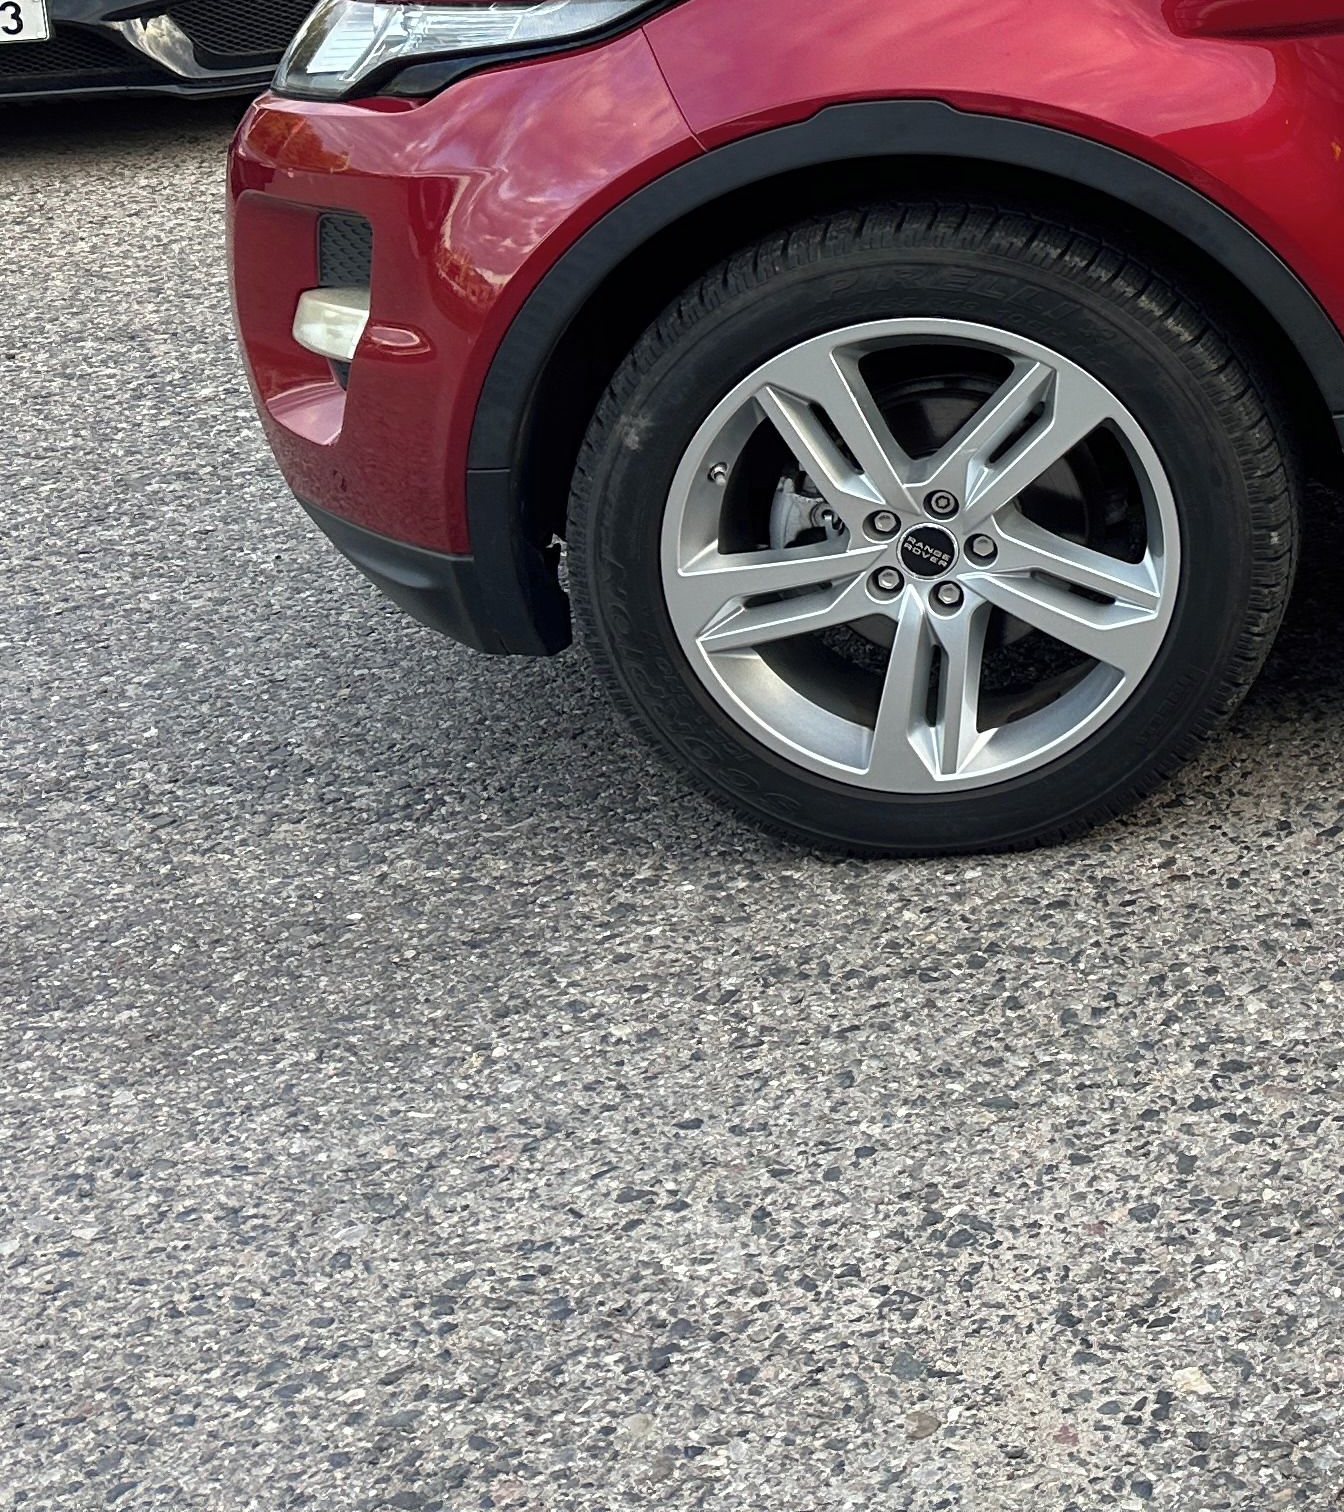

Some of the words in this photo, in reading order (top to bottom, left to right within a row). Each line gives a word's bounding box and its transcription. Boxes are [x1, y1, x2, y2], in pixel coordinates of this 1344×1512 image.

[0, 0, 24, 36] 3
[904, 542, 948, 568] ROVER
[907, 535, 951, 562] RANGE
